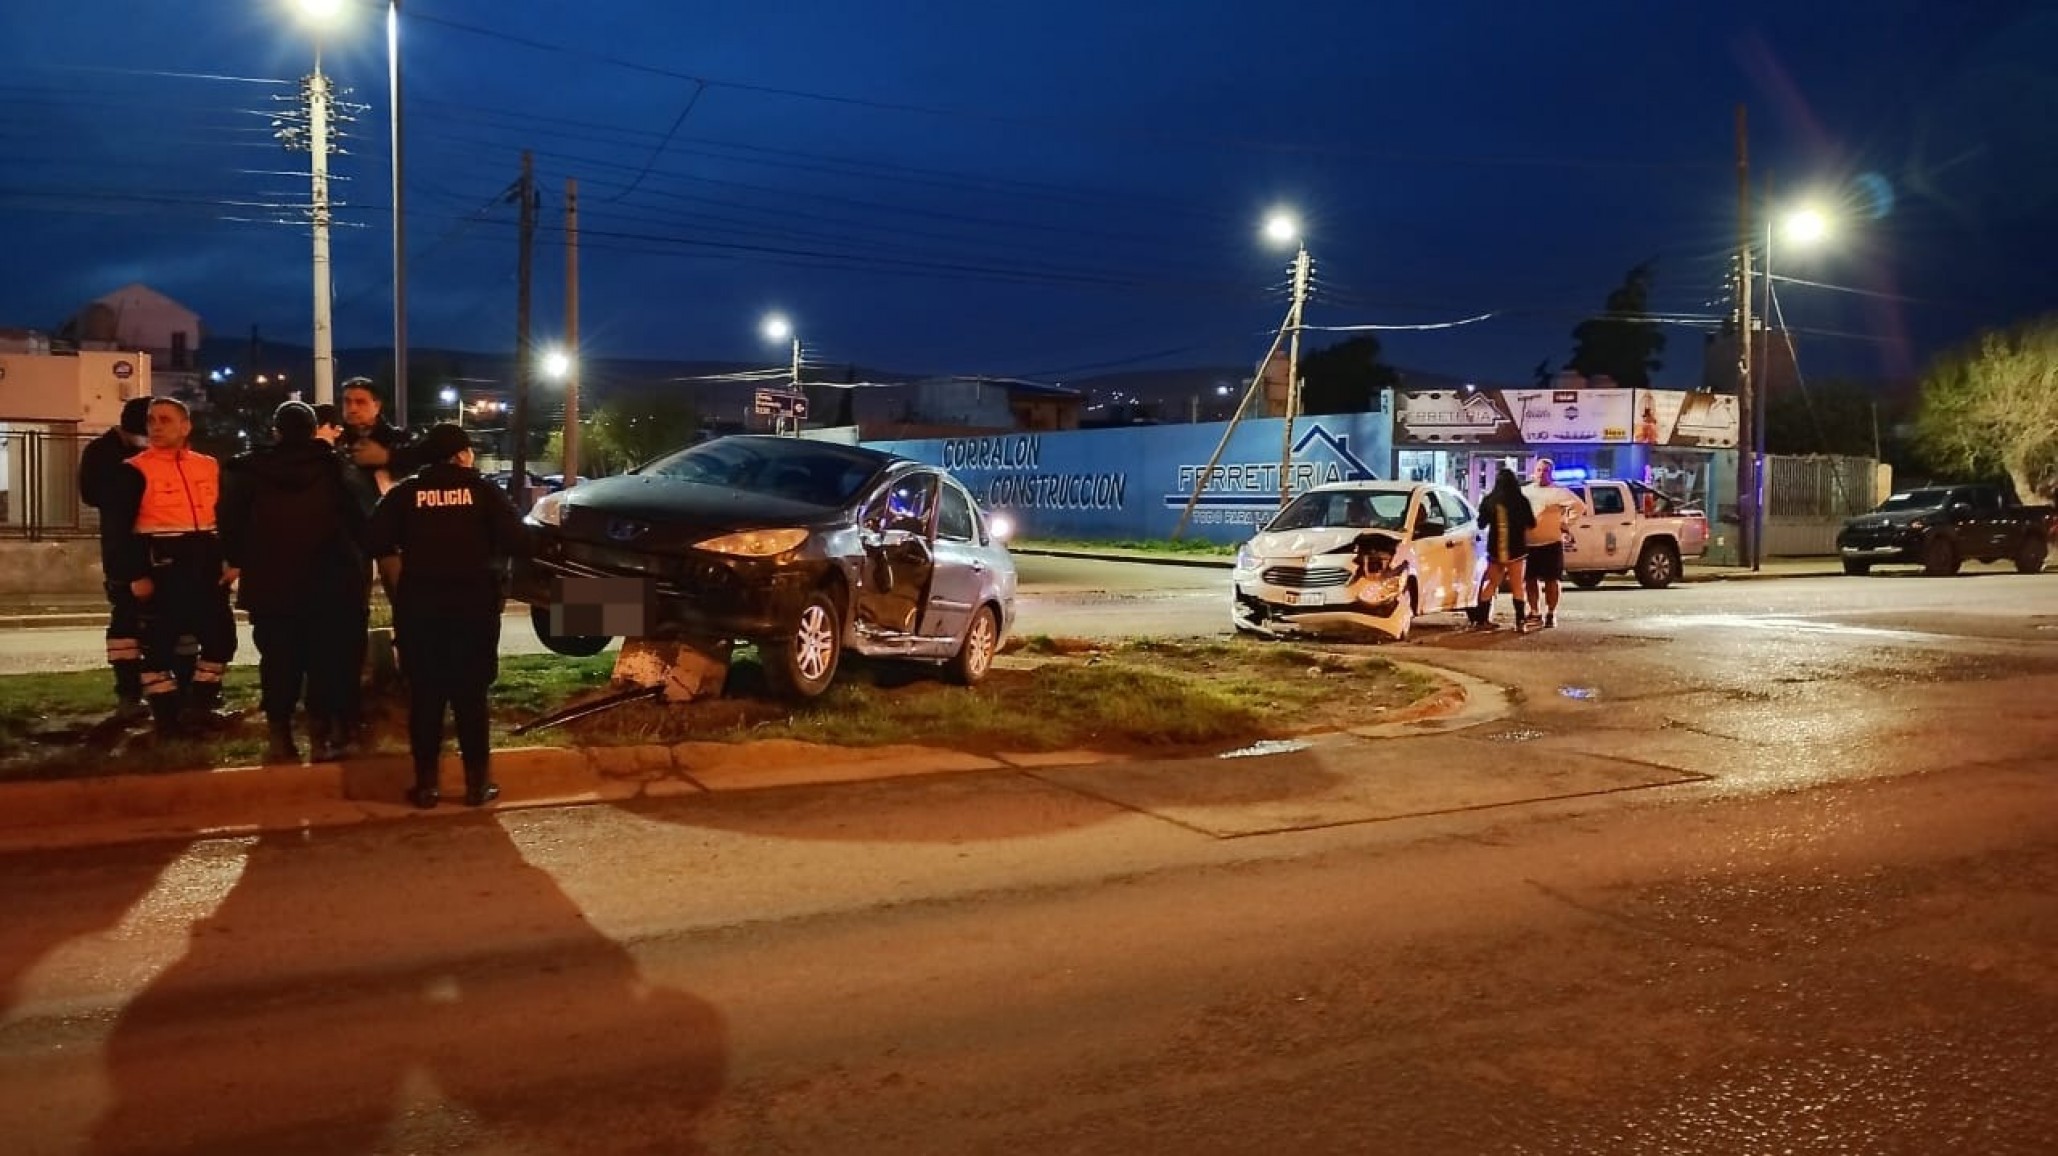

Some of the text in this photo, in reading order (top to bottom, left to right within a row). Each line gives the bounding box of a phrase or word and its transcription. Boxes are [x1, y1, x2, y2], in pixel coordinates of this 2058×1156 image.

[941, 435, 1041, 470] CORRALON
[989, 472, 1127, 511] CONSTRUCCION
[1178, 462, 1342, 492] FERRETERIA
